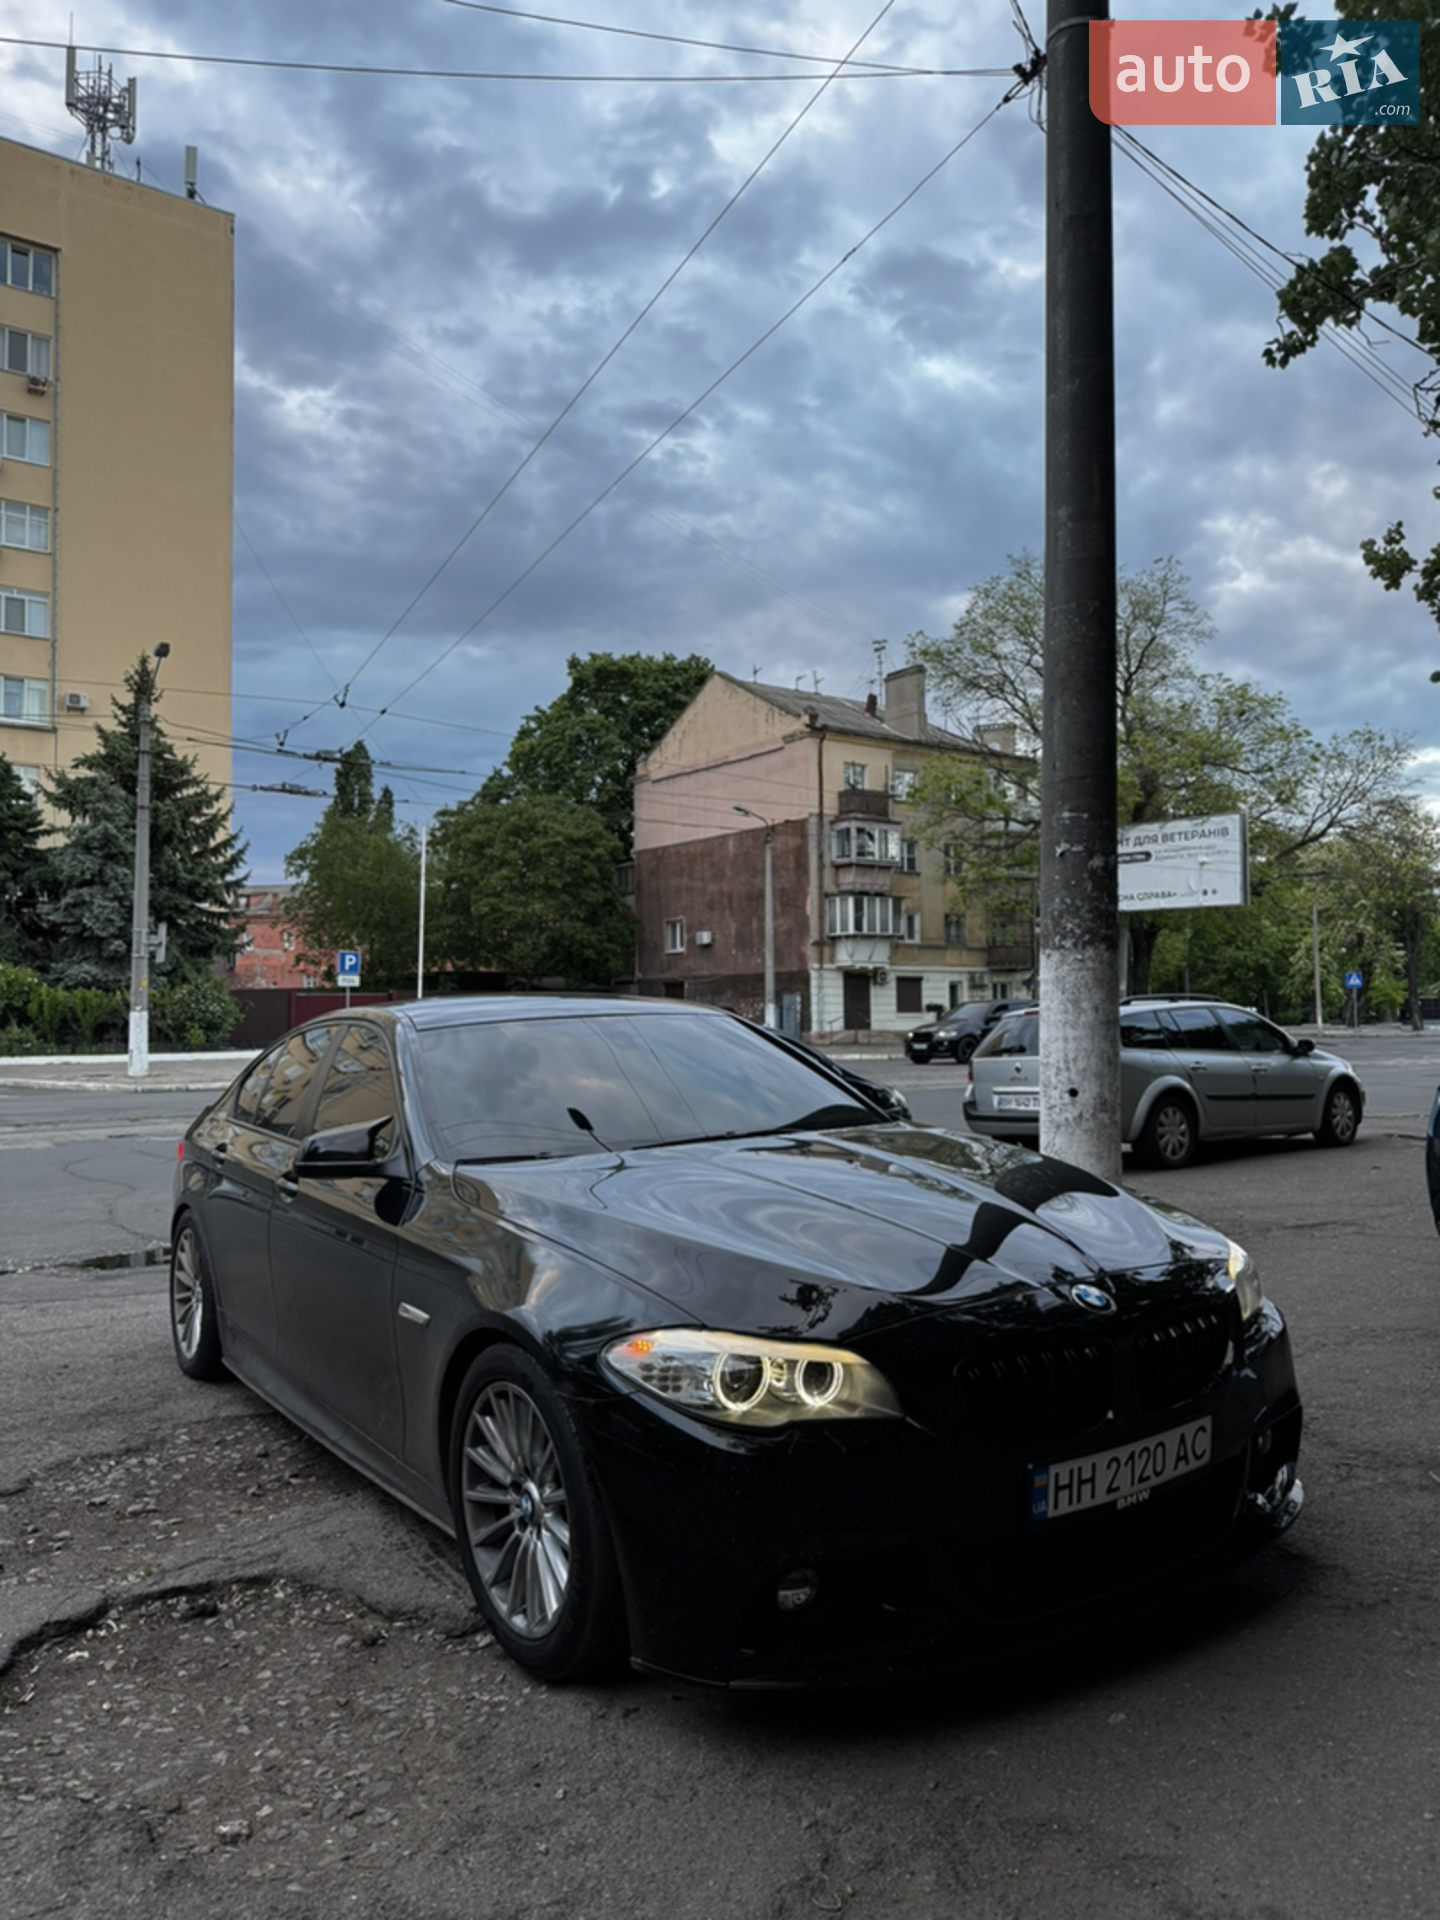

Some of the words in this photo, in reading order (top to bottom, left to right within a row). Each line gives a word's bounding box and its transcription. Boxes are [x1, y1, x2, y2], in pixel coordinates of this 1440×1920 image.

[1133, 834, 1159, 848] ДЛЯ
[1161, 826, 1230, 844] ВЕТЕРАНІВ
[345, 954, 357, 971] P
[1053, 1462, 1096, 1510] HH
[1105, 1440, 1166, 1495] 2120
[1173, 1425, 1207, 1471] AC
[1032, 1500, 1047, 1515] UA
[1116, 1489, 1151, 1510] BMW
